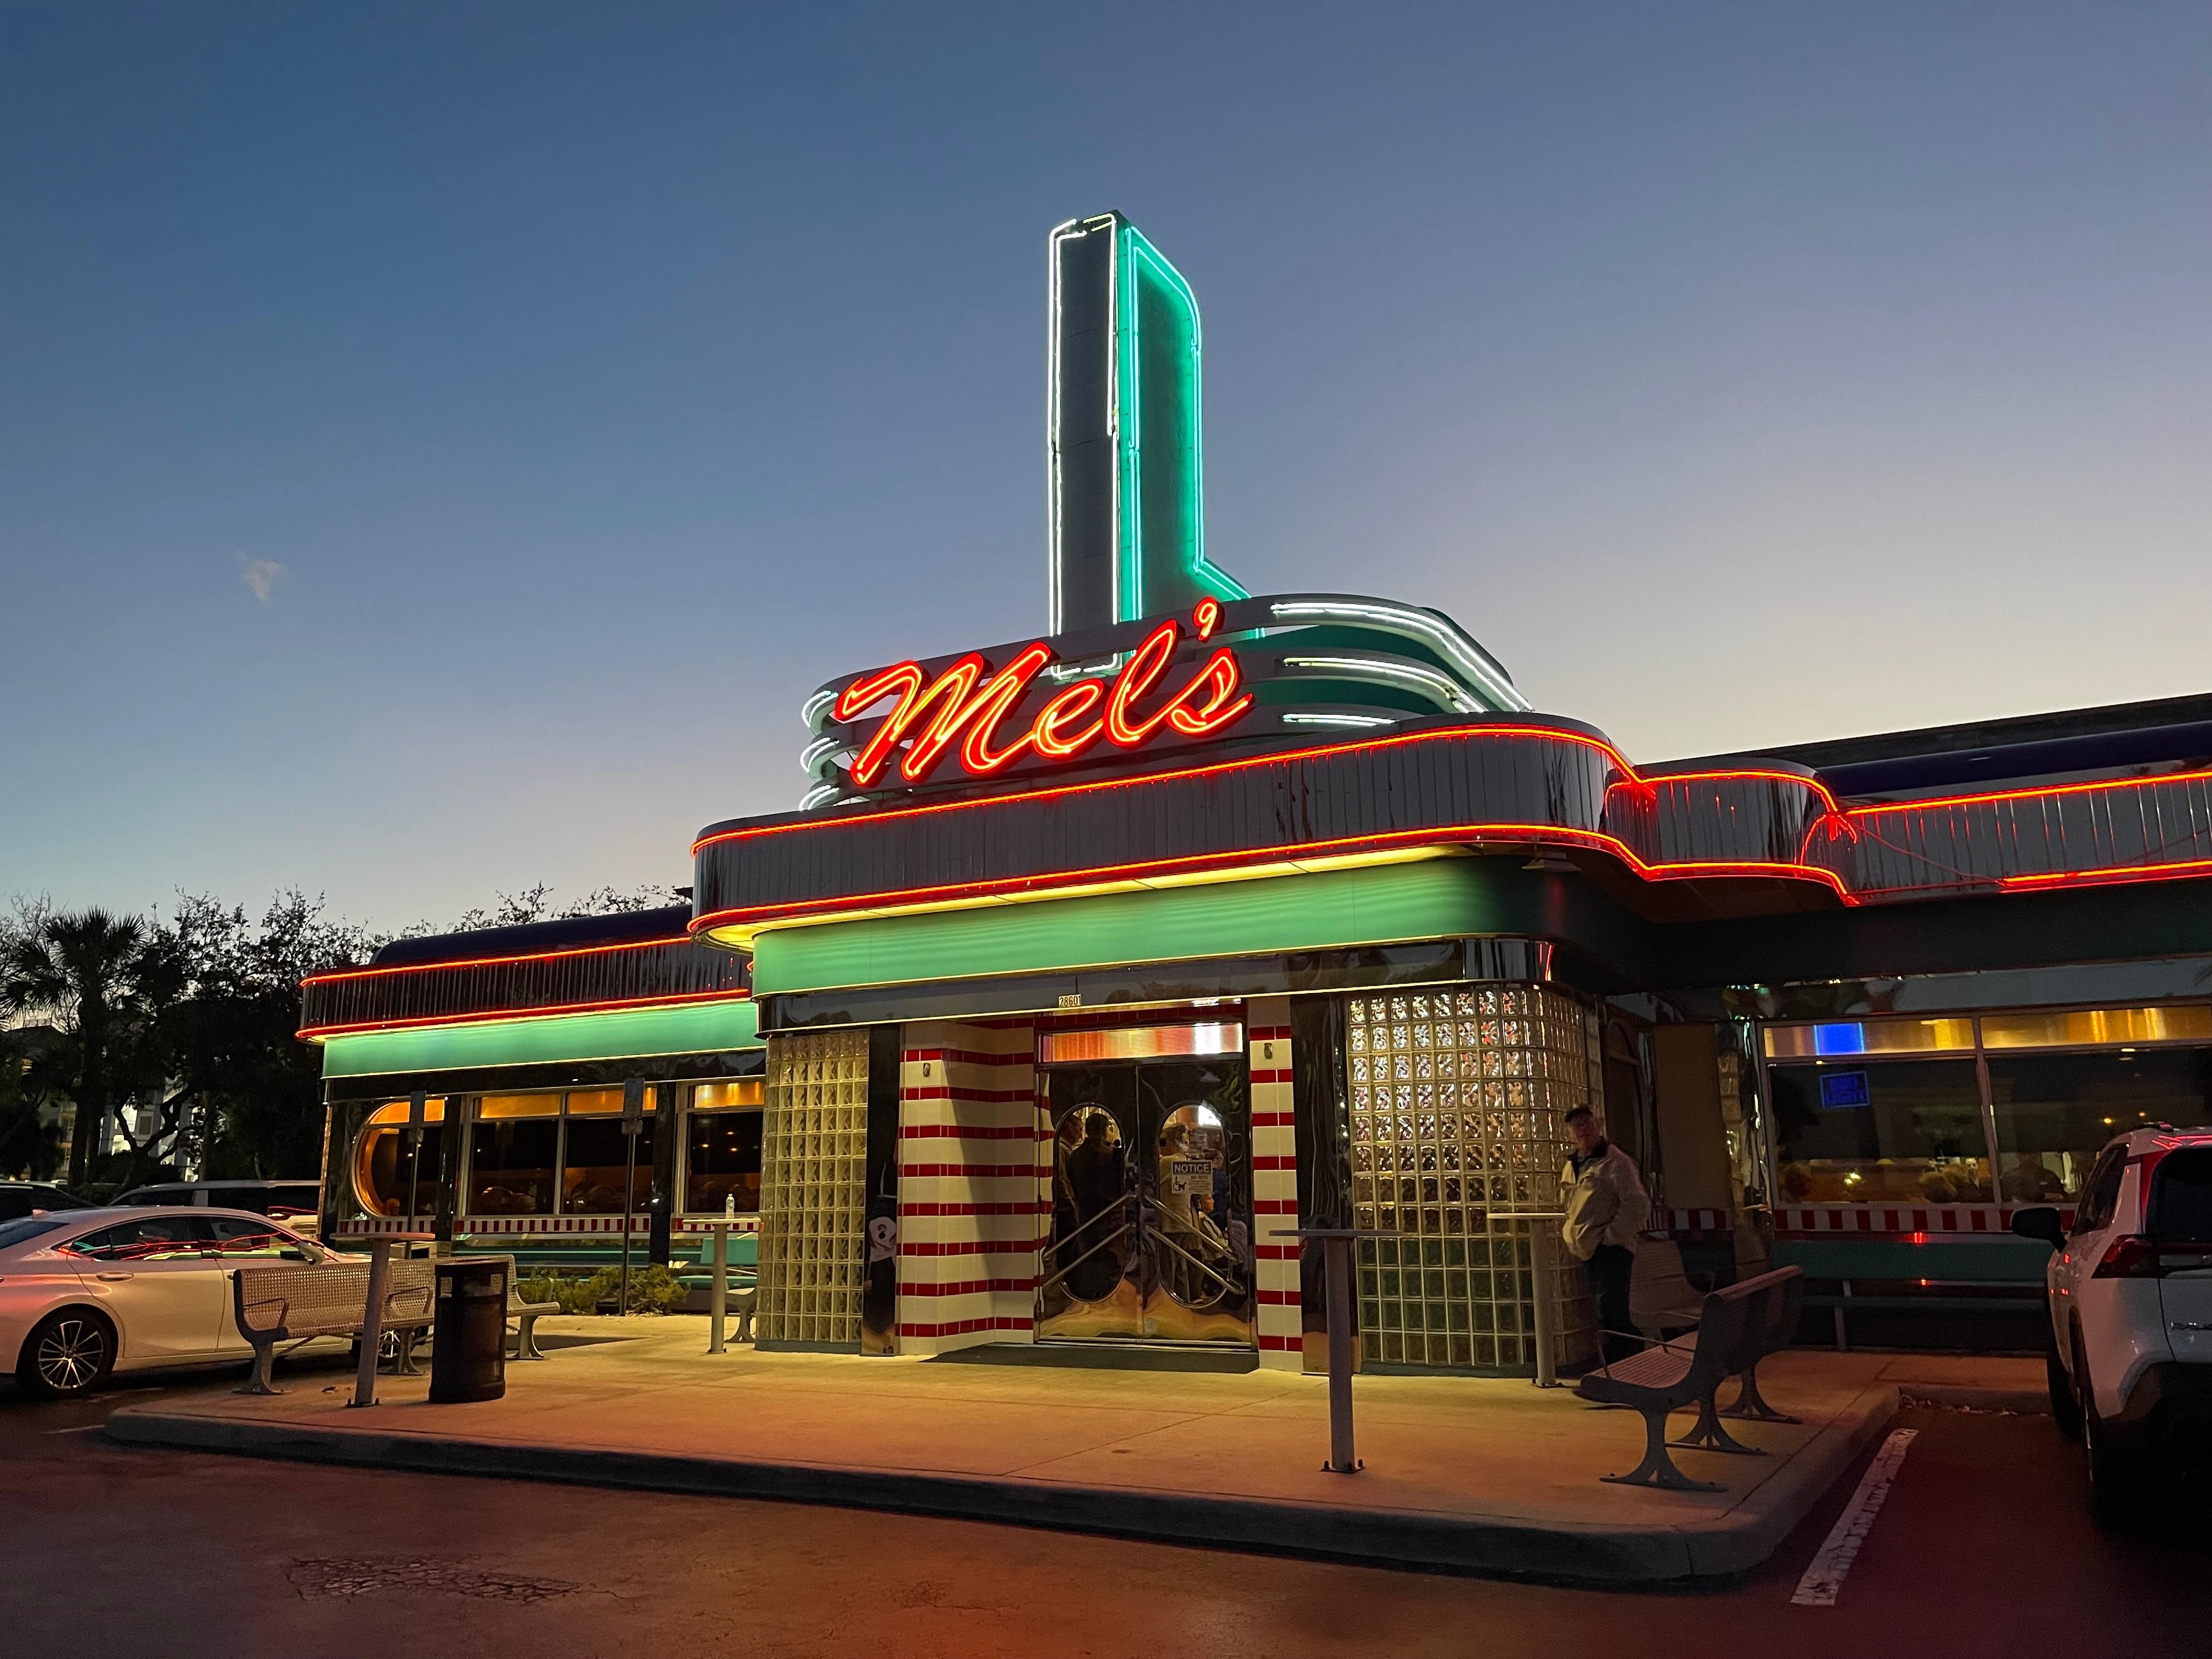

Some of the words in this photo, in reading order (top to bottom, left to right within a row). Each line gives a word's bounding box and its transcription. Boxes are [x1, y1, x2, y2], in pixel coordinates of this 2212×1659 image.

[835, 597, 1253, 786] Mel's
[1059, 995, 1081, 1007] 28601
[1174, 1164, 1210, 1173] NOTICE
